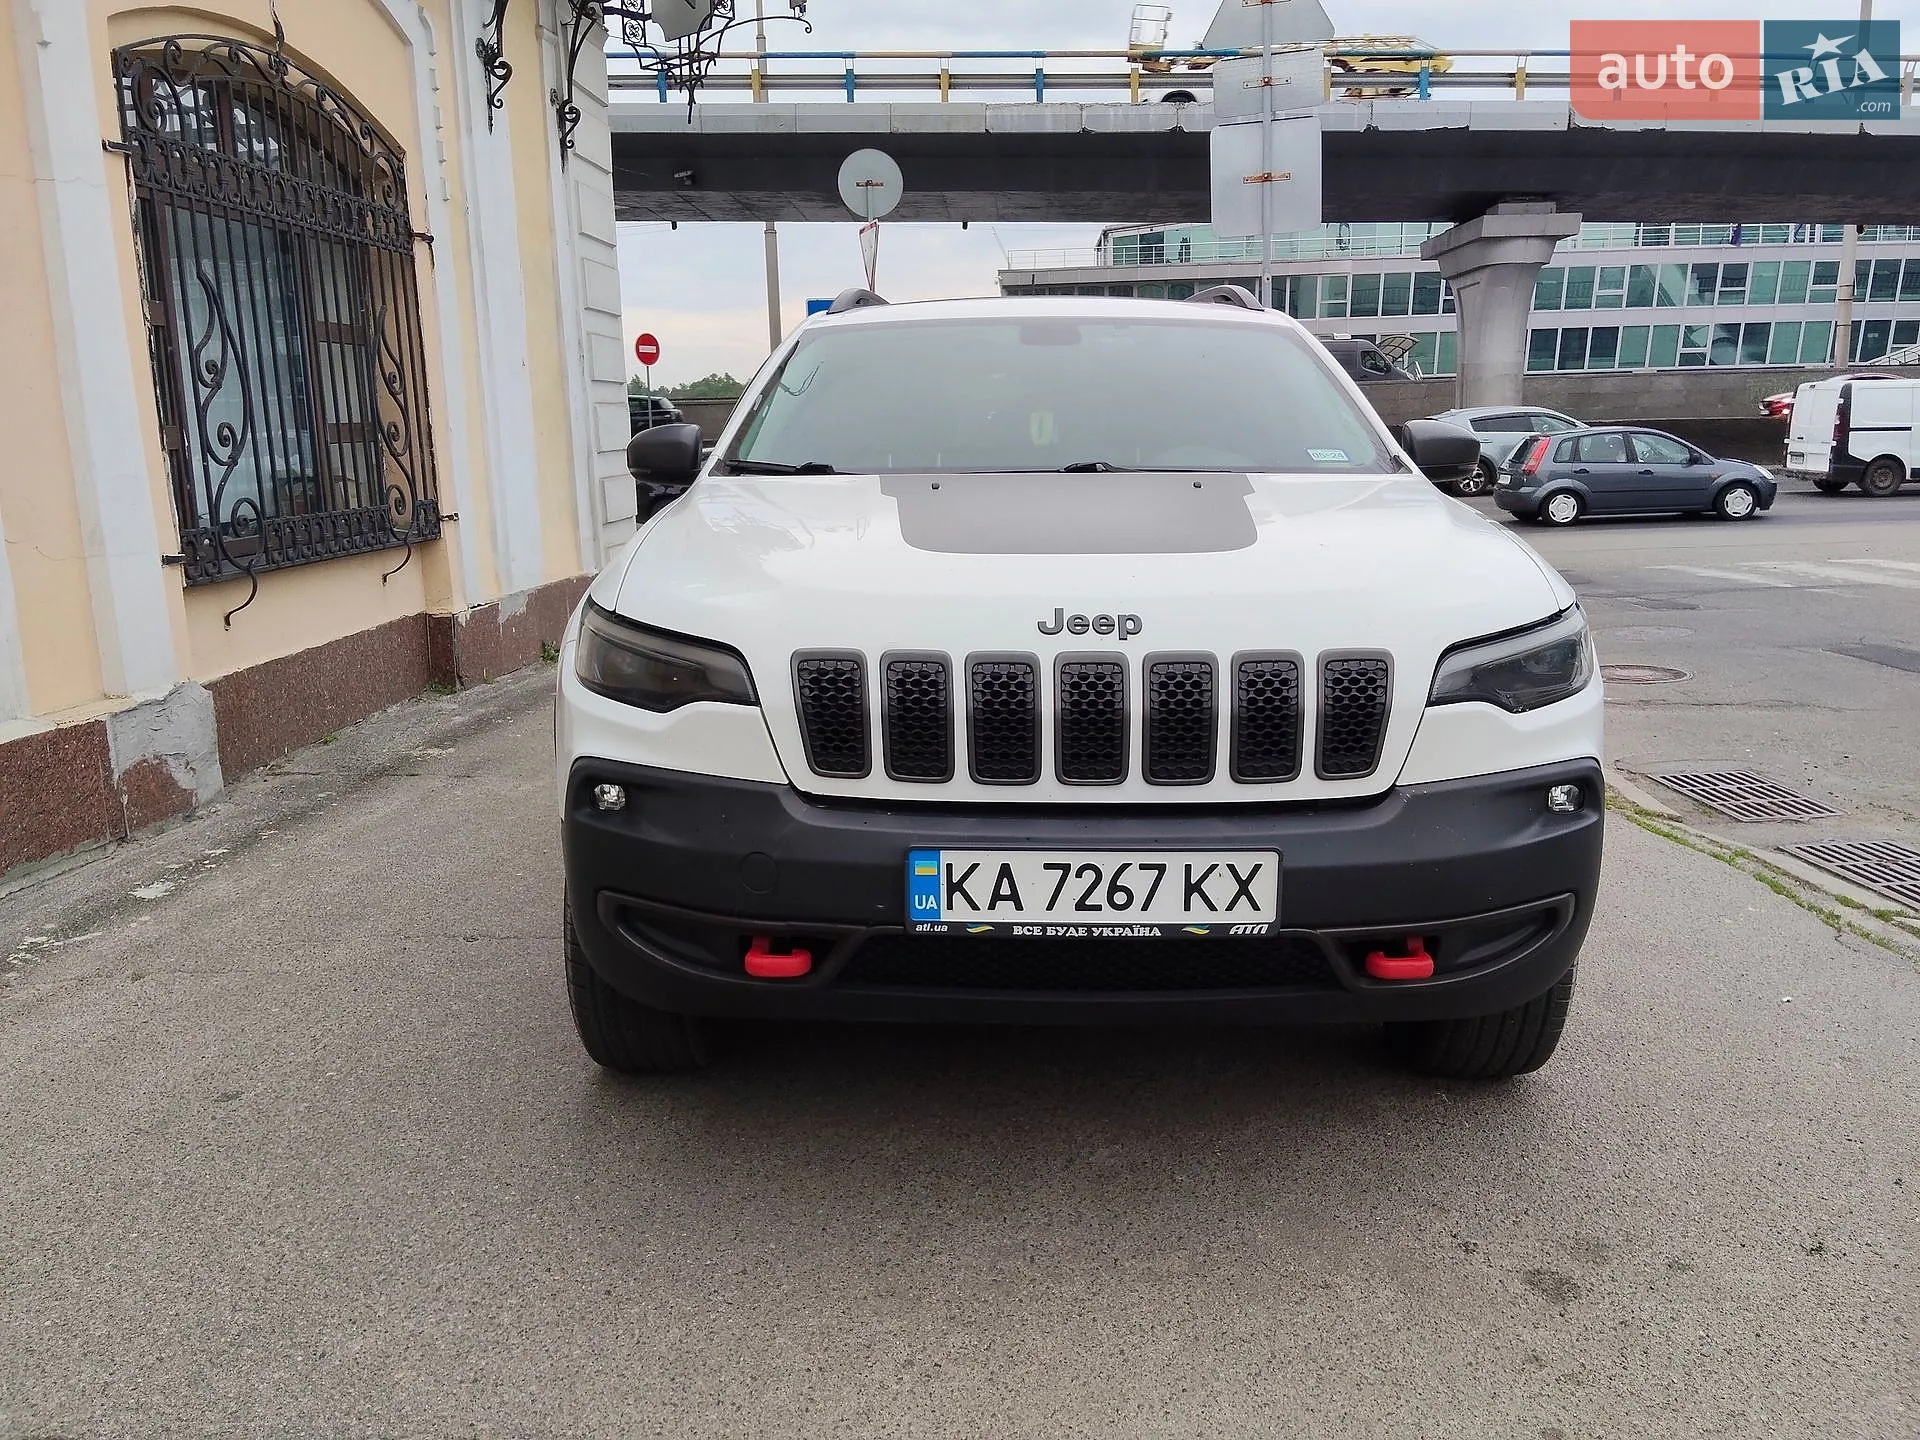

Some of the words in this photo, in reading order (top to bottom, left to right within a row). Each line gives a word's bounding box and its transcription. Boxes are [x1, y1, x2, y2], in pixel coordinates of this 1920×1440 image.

[1037, 607, 1143, 641] Jeep
[945, 863, 1025, 912] KA
[1043, 863, 1167, 912] 7267
[1183, 863, 1264, 912] KX
[914, 895, 938, 910] UA
[915, 923, 949, 932] atl.ua
[1012, 925, 1043, 936] ВСЕ
[1046, 925, 1088, 937] БУДЕ
[1091, 924, 1162, 937] УКРАЇНА
